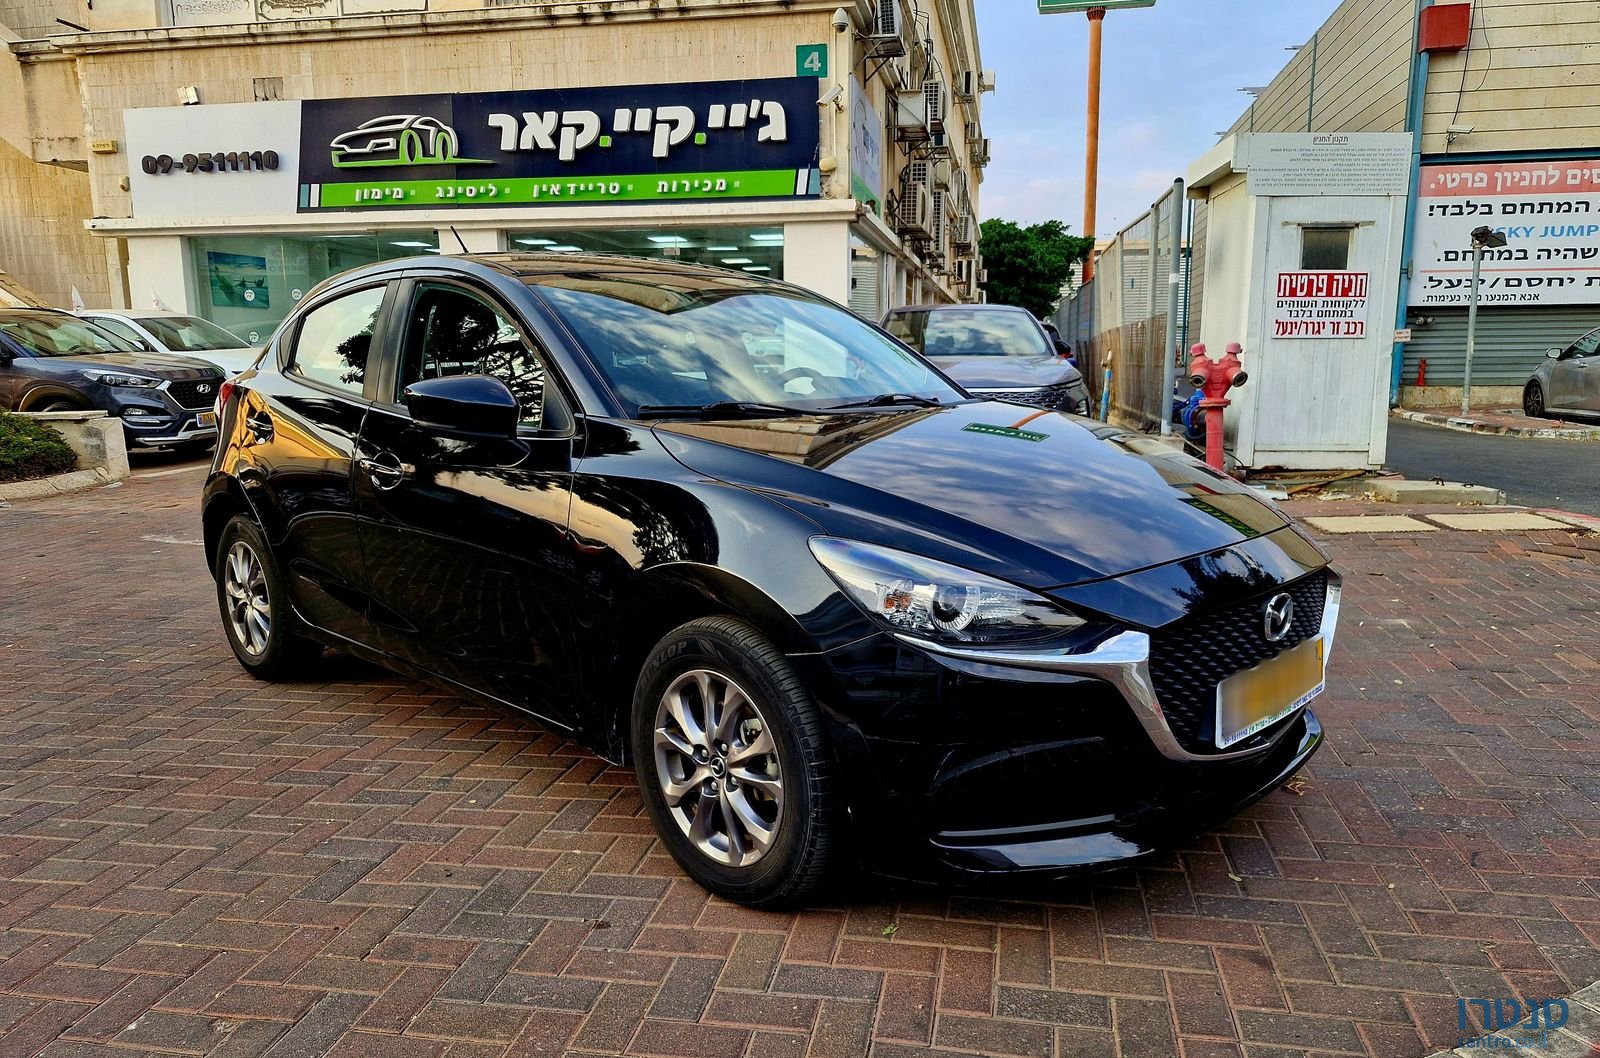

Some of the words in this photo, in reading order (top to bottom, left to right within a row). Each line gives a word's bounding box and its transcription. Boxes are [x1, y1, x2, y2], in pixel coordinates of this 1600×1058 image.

[804, 52, 821, 71] 4
[142, 150, 279, 174] 09-9511110
[1430, 172, 1488, 189] פרטי.
[1494, 164, 1560, 192] לחניון
[436, 183, 498, 198] ליסינג
[656, 179, 727, 193] מכירות
[355, 187, 404, 202] מימון
[1428, 200, 1493, 216] בלבד!
[1501, 201, 1590, 215] המתחם
[1539, 224, 1600, 237] JUMP
[1536, 247, 1599, 260] שהיה
[1279, 274, 1328, 297] פרטית
[1332, 274, 1367, 296] חניה
[1277, 300, 1318, 308] השוהים
[1322, 299, 1365, 309] ללקוחות
[1485, 293, 1517, 302] המנעו
[1519, 293, 1540, 301] אנא
[1287, 309, 1313, 318] בלבד
[1317, 310, 1353, 318] במתחם
[1329, 321, 1341, 335] זר
[1344, 321, 1364, 335] רכב
